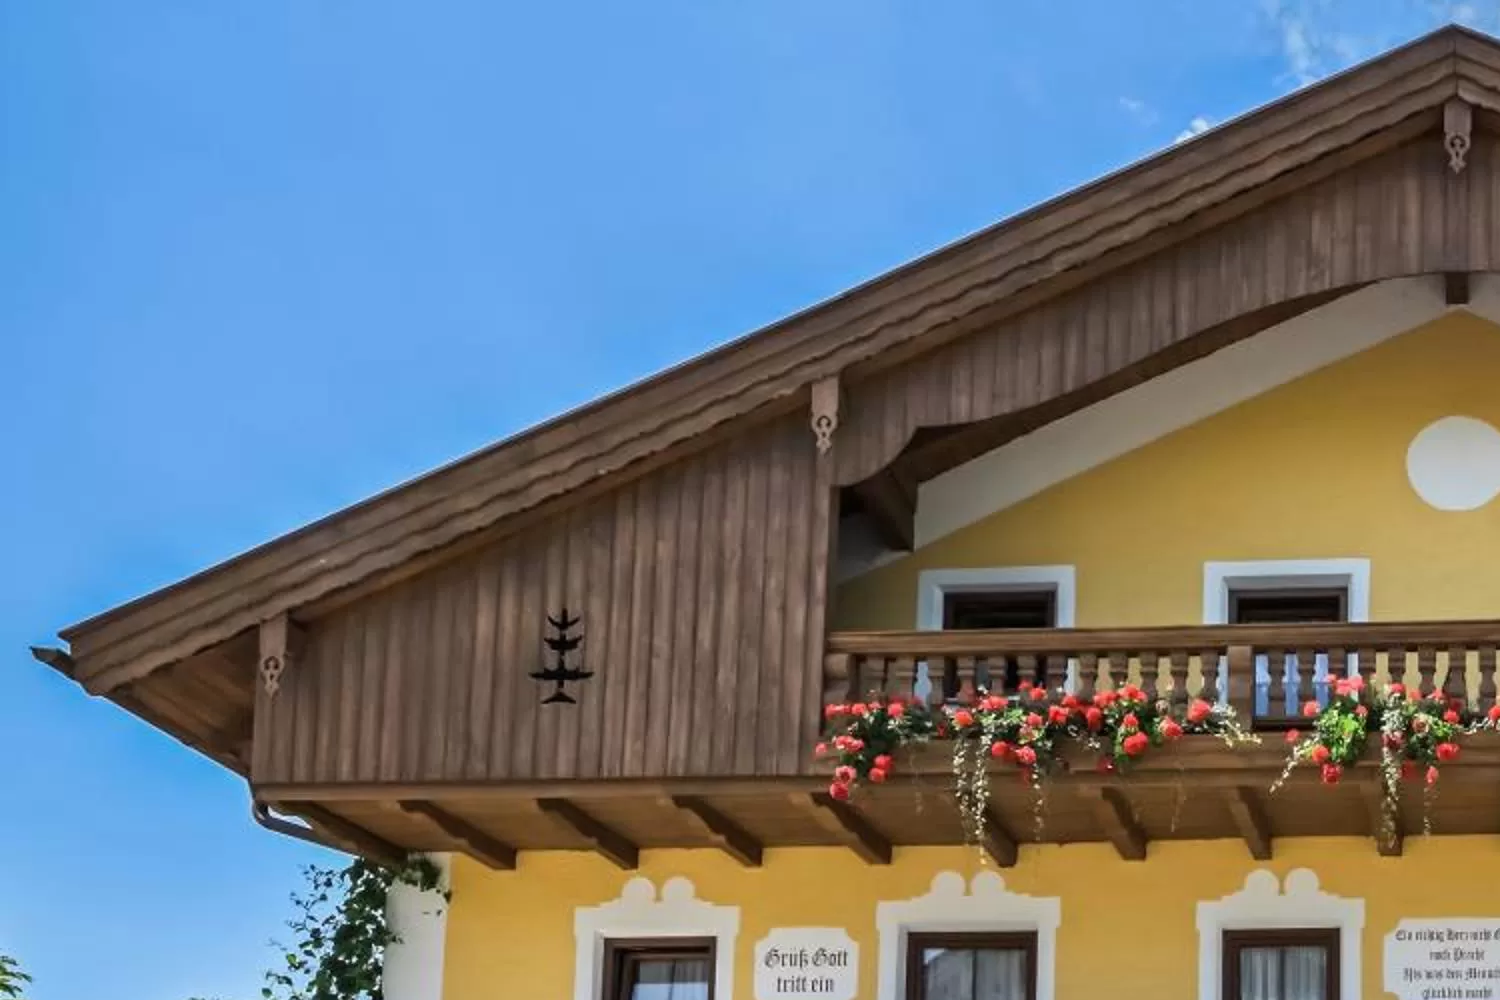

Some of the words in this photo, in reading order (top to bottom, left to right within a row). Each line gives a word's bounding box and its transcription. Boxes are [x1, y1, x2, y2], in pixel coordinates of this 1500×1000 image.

[812, 946, 848, 967] Gott
[776, 975, 807, 992] tritt
[811, 976, 835, 992] ein
